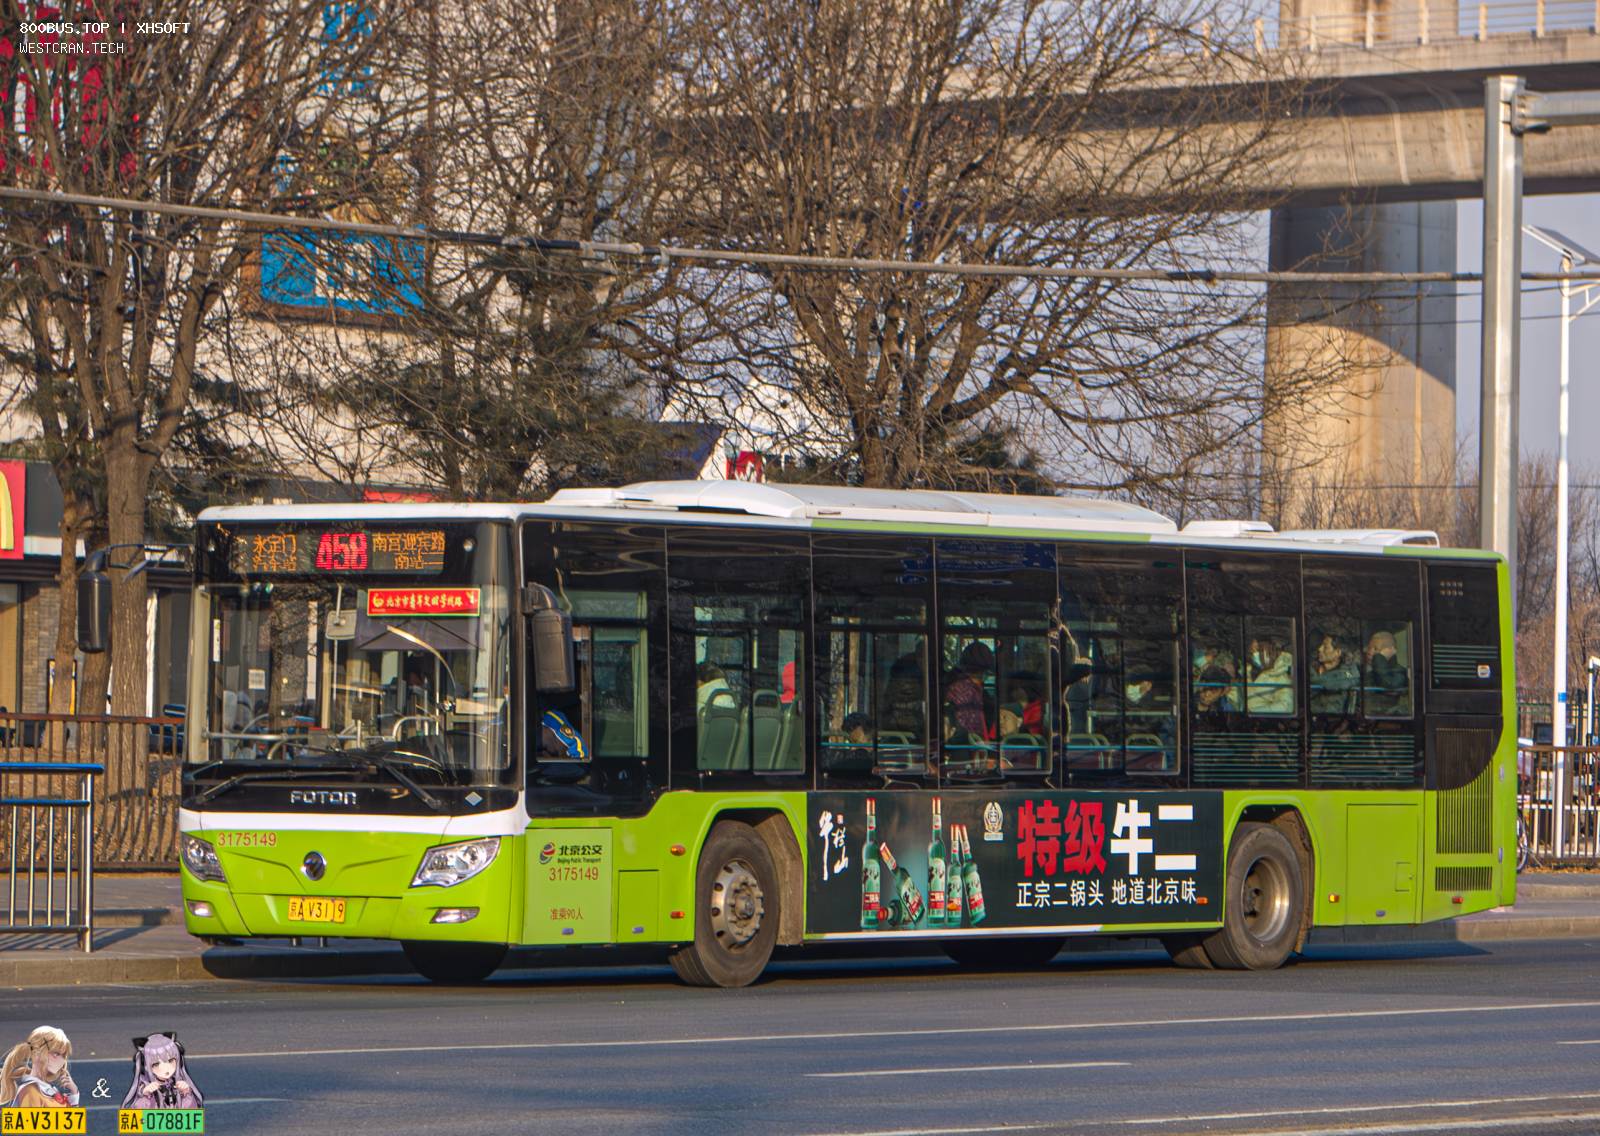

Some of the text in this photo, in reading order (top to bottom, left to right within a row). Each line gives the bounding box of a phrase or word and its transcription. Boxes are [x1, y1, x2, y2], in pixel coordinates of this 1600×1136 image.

[252, 533, 297, 553] 永定门
[315, 532, 368, 570] 458
[290, 790, 357, 805] FOTON
[217, 832, 277, 847] 3175149
[558, 844, 603, 856] 北京公交
[549, 866, 599, 881] 3175149
[1016, 876, 1198, 908] 正宗二锅头 地道北京味
